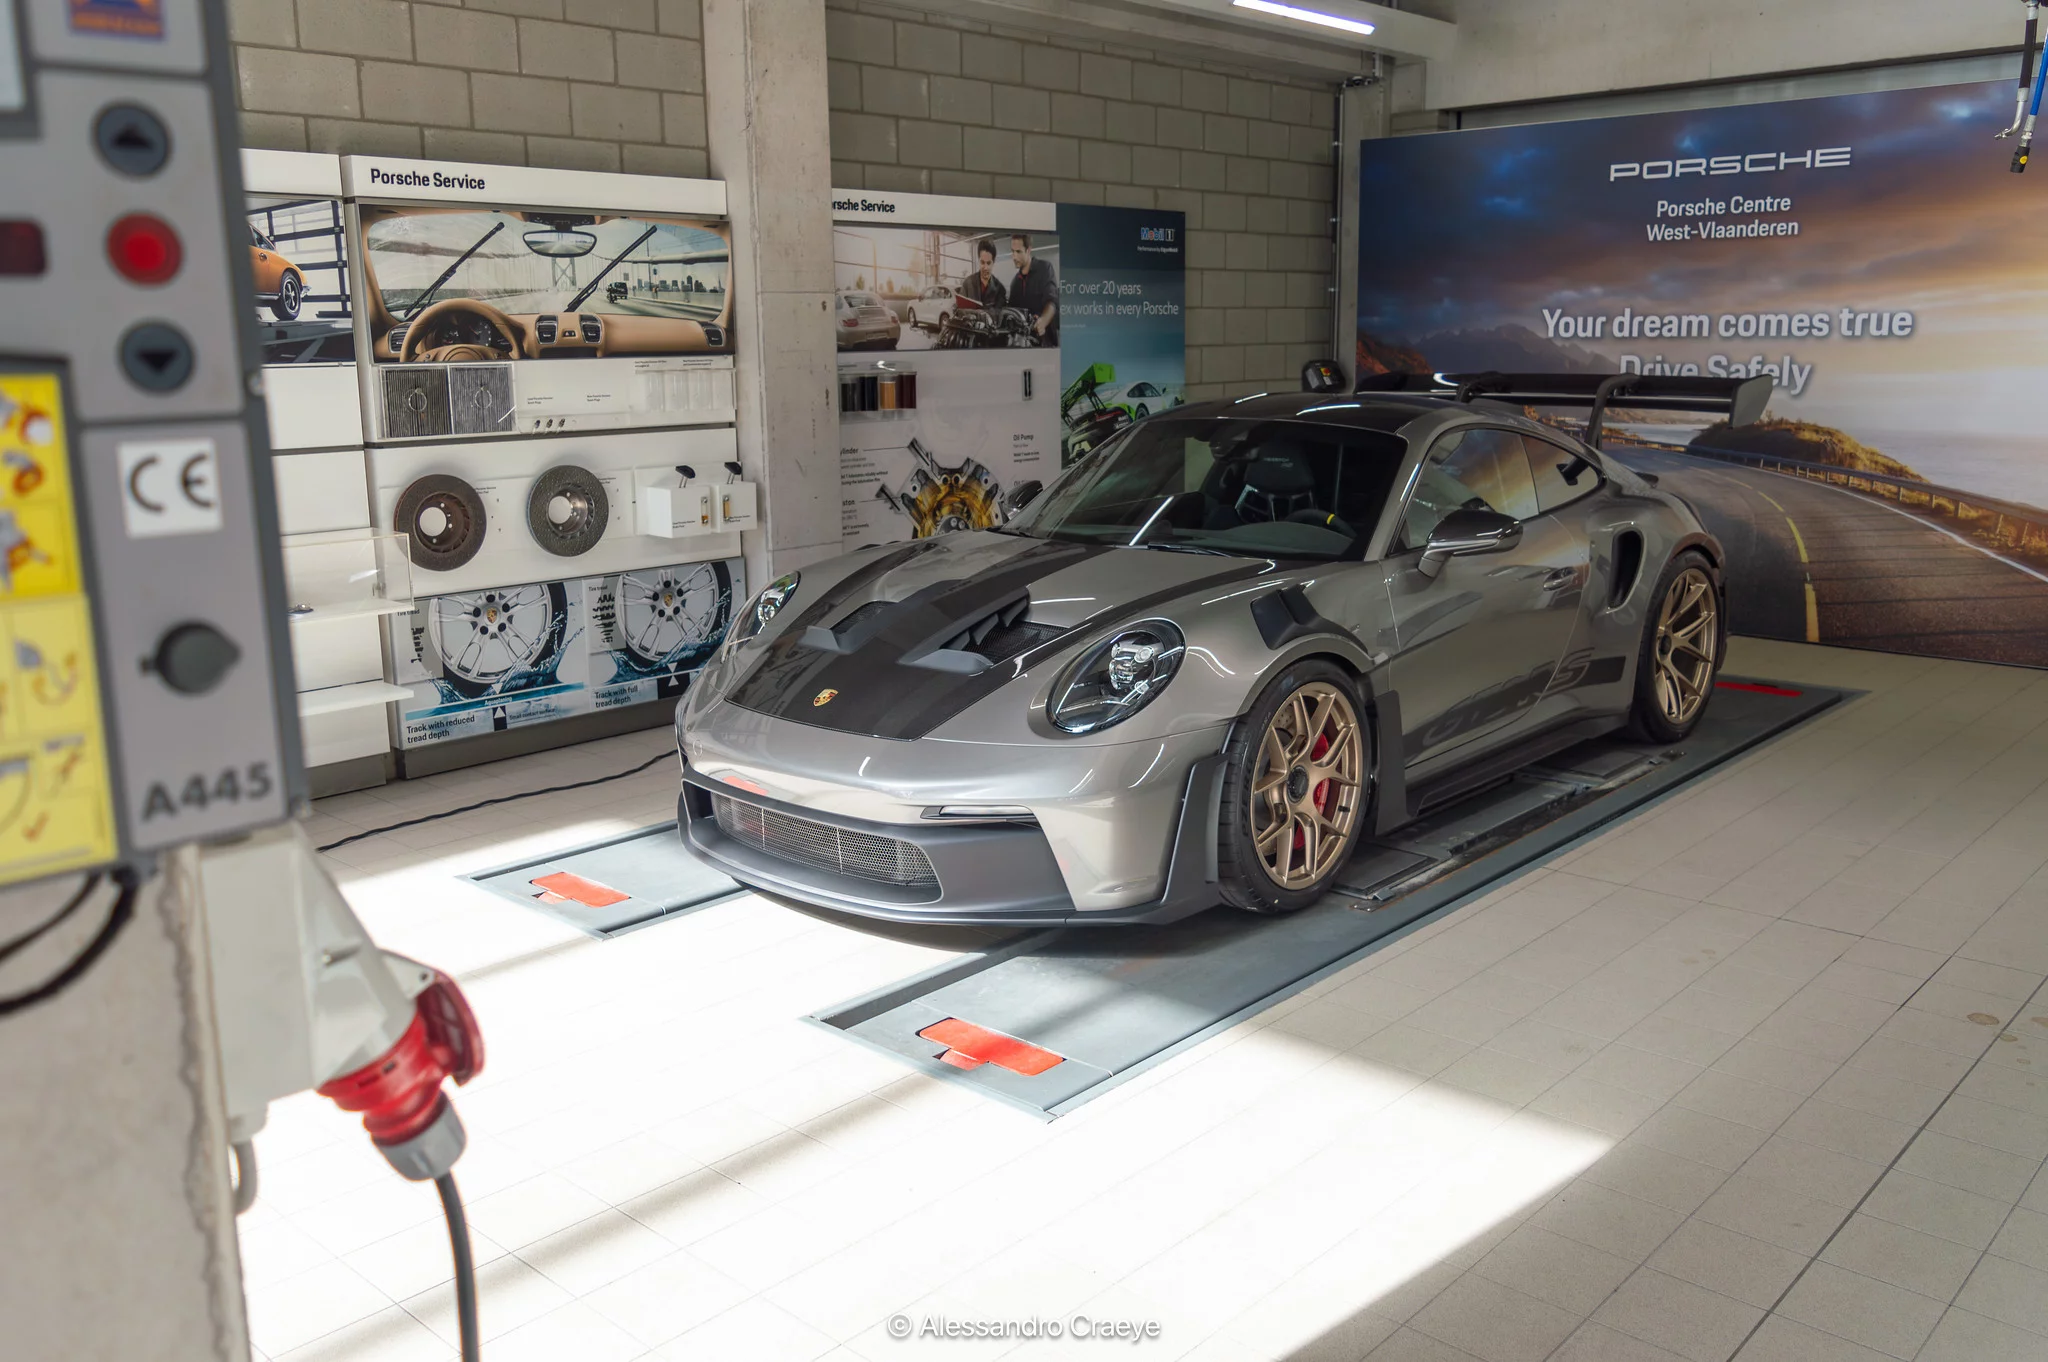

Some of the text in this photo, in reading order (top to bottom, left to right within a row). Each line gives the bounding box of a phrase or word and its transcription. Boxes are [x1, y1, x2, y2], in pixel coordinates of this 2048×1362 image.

[1609, 147, 1852, 182] PORSCHE
[370, 168, 486, 190] Porsche Service
[832, 198, 896, 213] rsche Service
[1656, 195, 1792, 218] Porsche Centre
[1140, 227, 1165, 241] Mobil
[1646, 219, 1800, 242] West-Vlaanderen
[1060, 280, 1142, 298] For over 20 years
[1060, 301, 1179, 319] ex works in every Porsche
[1542, 306, 1913, 338] Your dream comes true
[1619, 353, 1812, 396] Drive Safely
[127, 452, 216, 514] CE
[595, 685, 638, 699] Track with full
[595, 696, 632, 708] tread depth
[407, 715, 475, 734] Track with reduced
[407, 729, 450, 744] tread depth
[141, 761, 273, 823] A445
